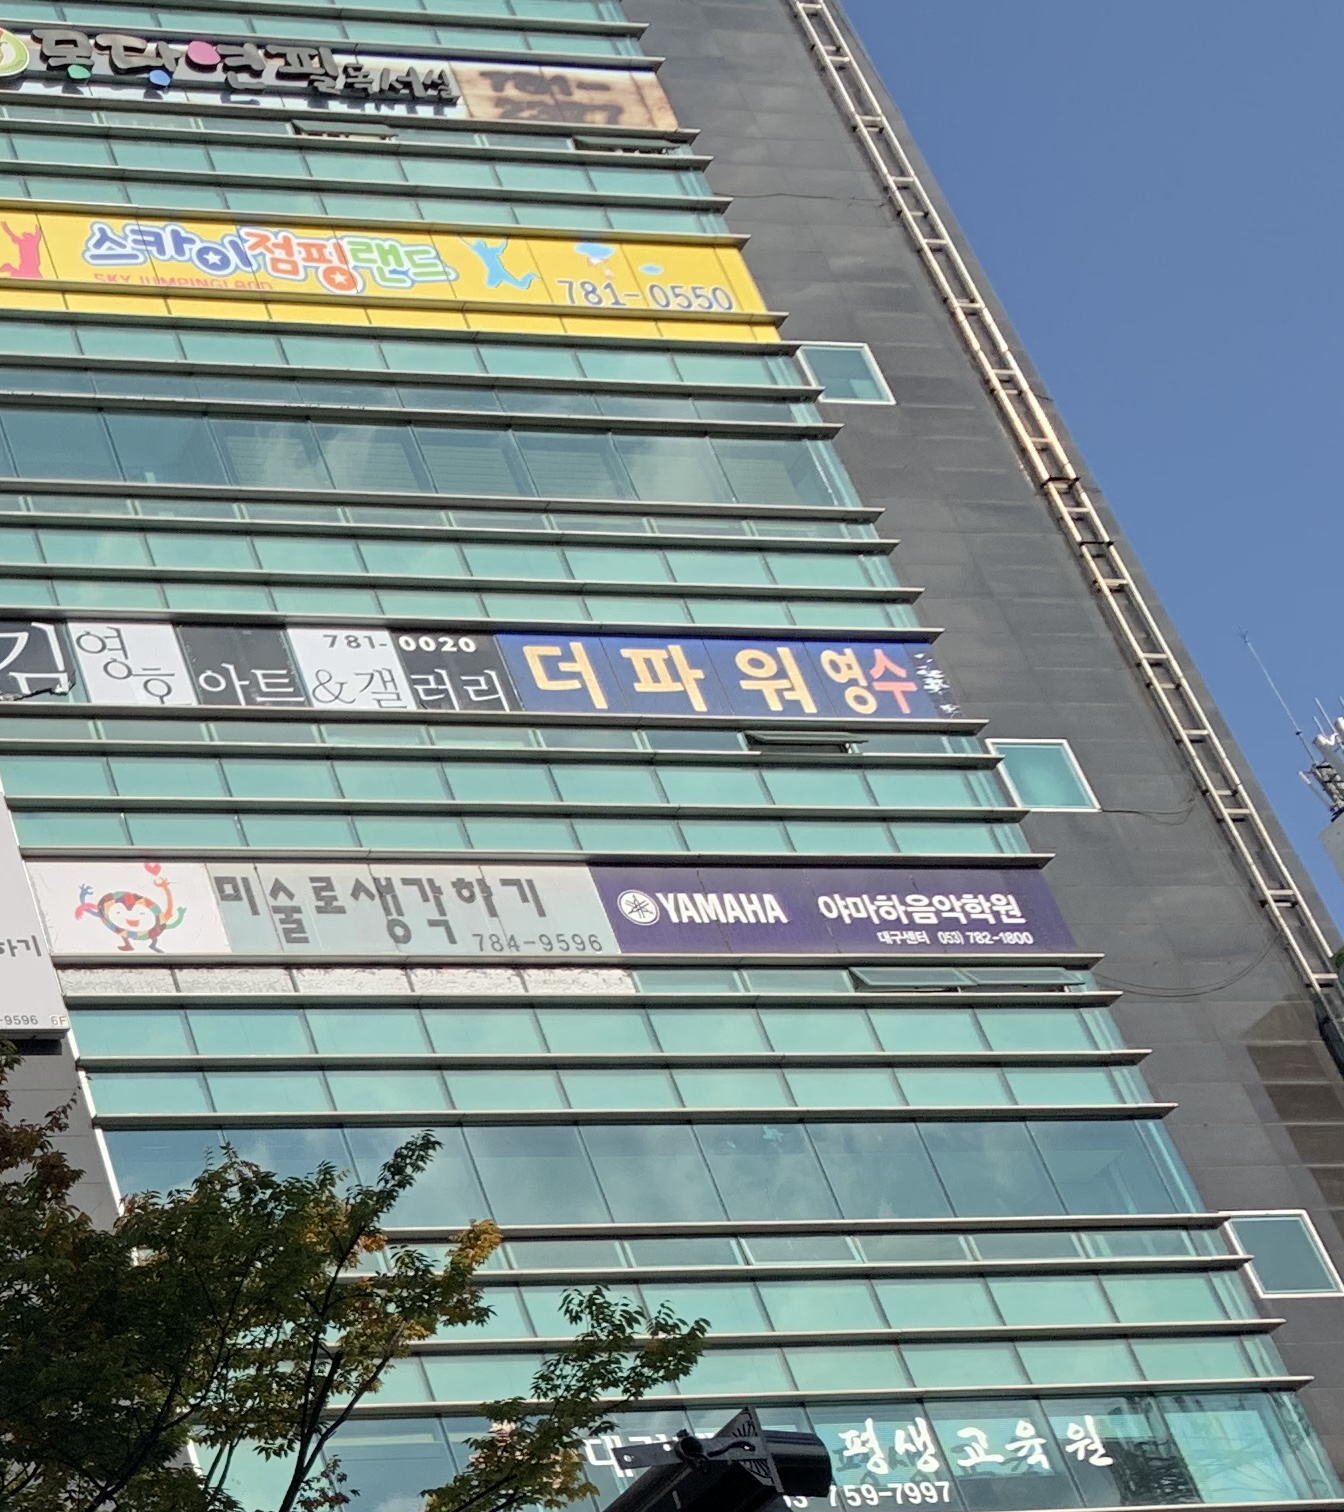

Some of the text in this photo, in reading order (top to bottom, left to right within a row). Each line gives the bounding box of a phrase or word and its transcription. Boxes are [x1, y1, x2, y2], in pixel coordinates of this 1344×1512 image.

[83, 223, 458, 295] 스카이점핑랜드
[558, 279, 733, 311] 781-0550
[321, 633, 477, 654] 781-0020
[215, 874, 548, 944] 미술로생각하기
[655, 892, 1027, 925] YAMAHA 야마하음악학원
[472, 933, 604, 953] 784-9596
[877, 930, 1035, 945] 대구센터 053) 782-1800
[50, 1017, 68, 1027] 6F
[837, 1415, 1115, 1474] 평생교육원
